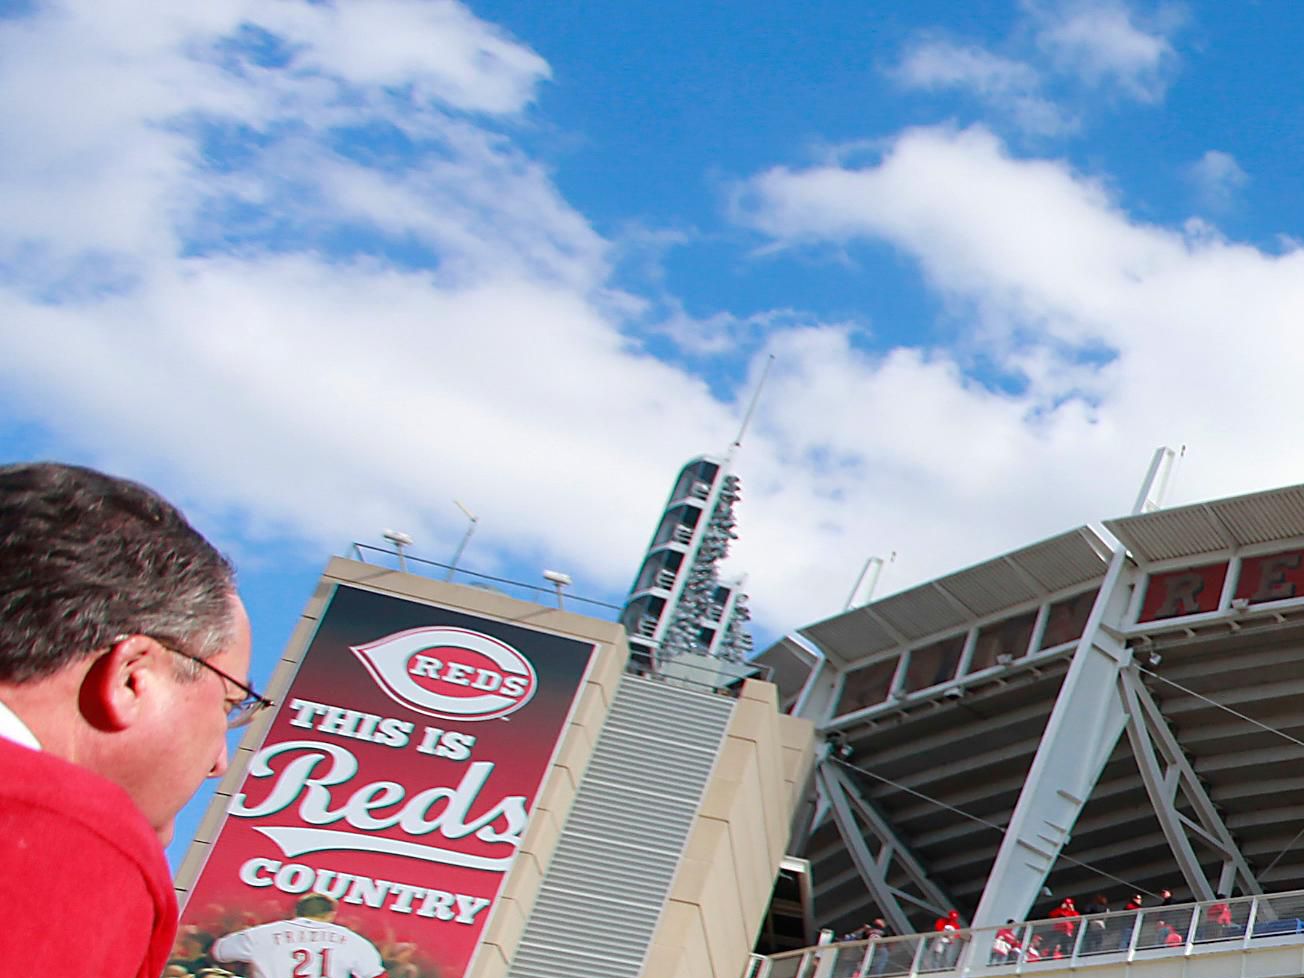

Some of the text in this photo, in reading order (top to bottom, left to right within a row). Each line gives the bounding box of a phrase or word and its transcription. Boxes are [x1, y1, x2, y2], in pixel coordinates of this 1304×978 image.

[409, 652, 531, 700] REDS
[289, 698, 477, 762] THIS IS
[228, 739, 530, 845] Reds
[239, 857, 492, 927] COUNTRY
